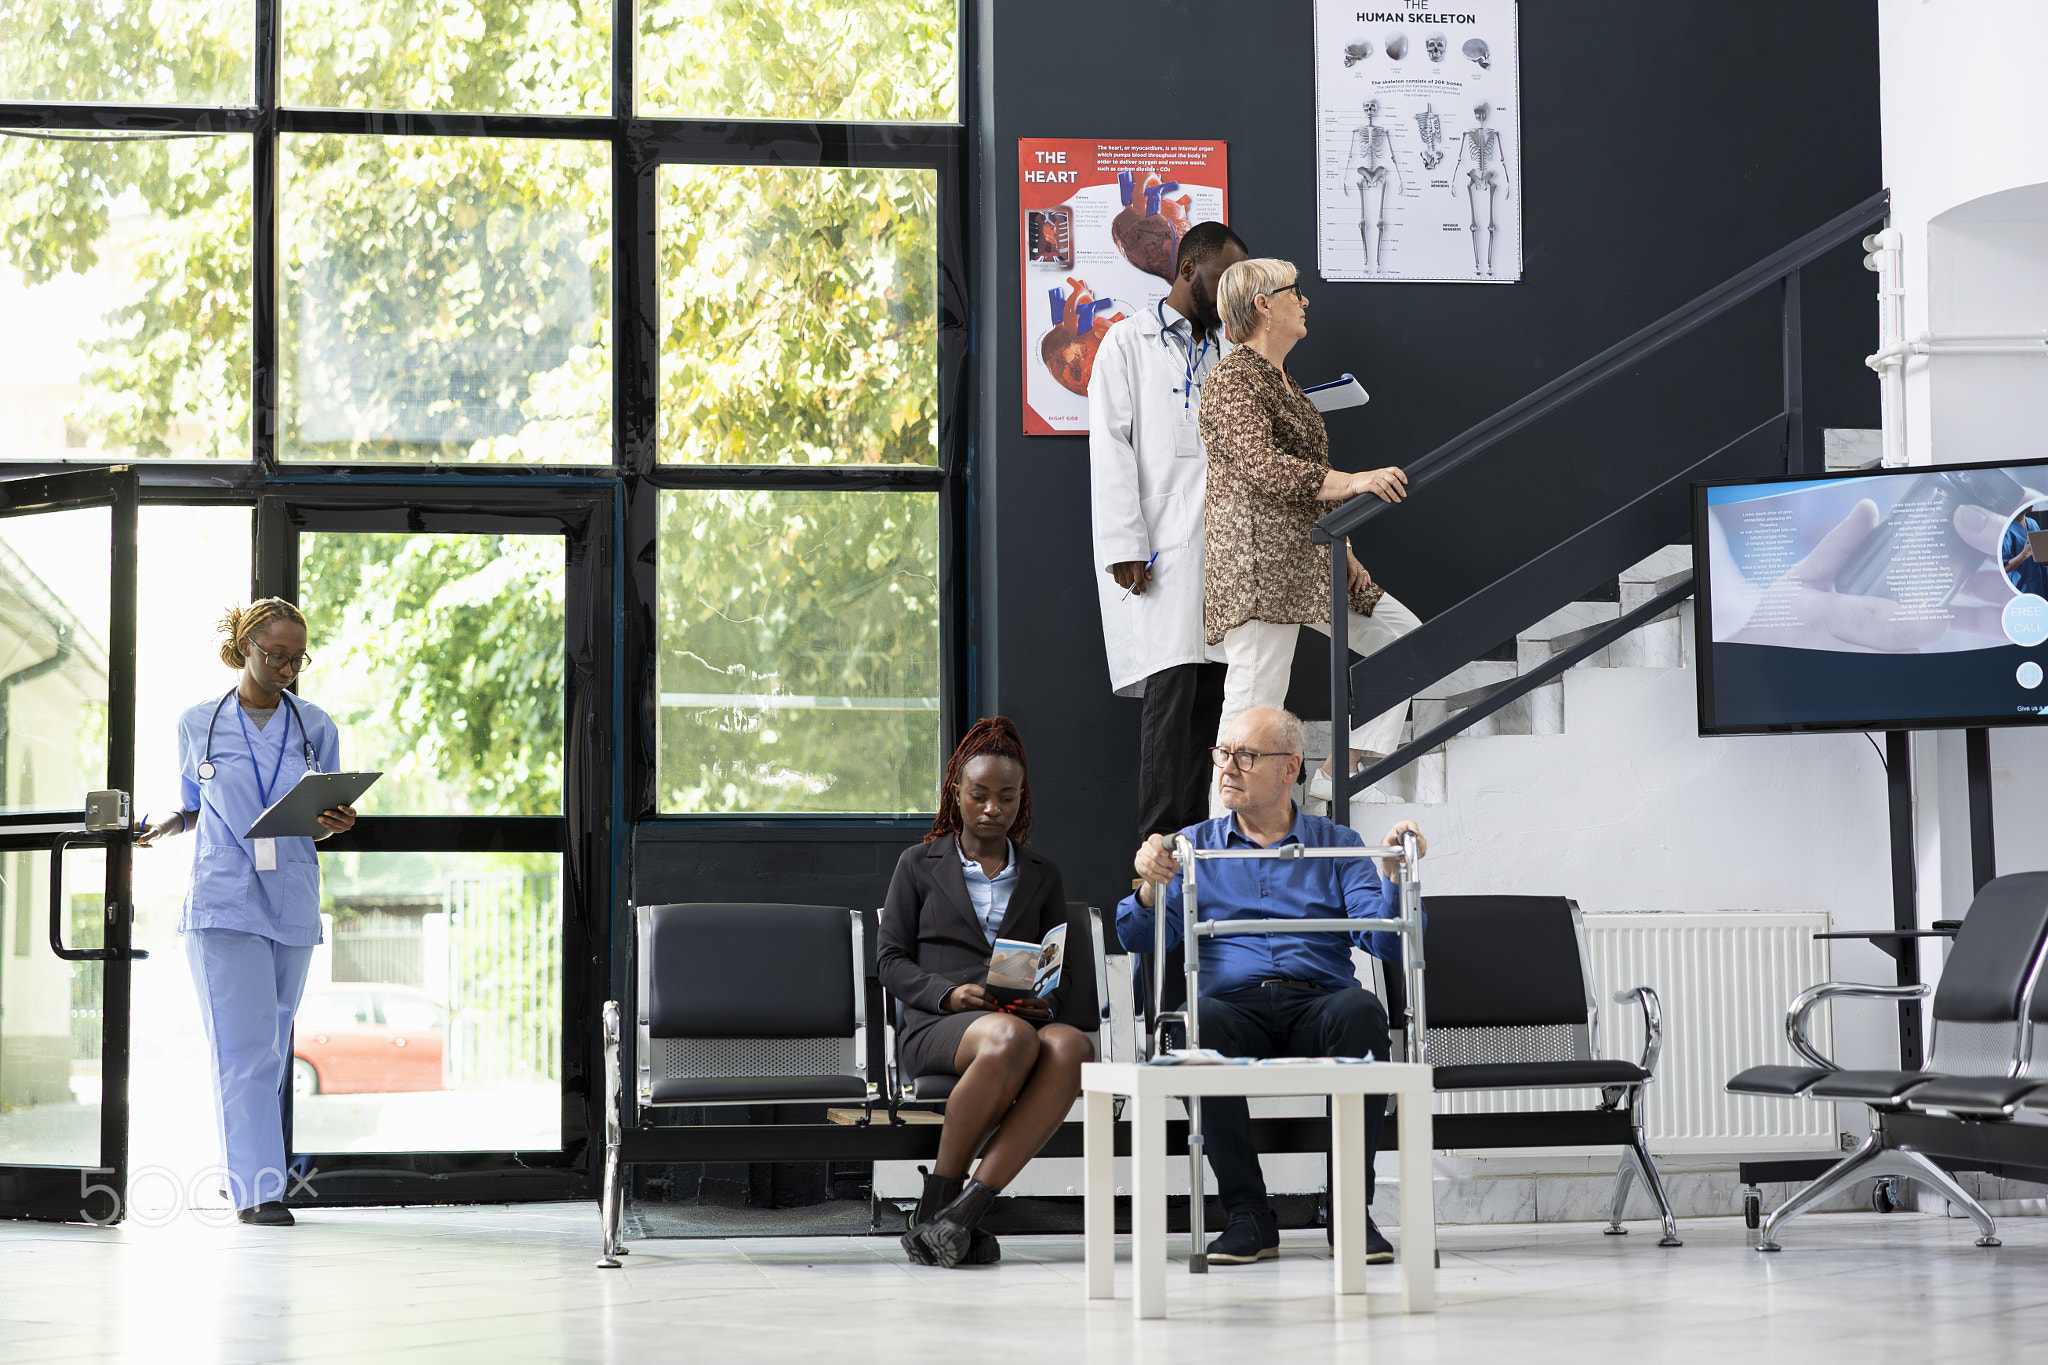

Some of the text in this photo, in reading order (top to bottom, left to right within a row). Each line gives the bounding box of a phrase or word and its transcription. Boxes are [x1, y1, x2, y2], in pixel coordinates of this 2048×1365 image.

[1404, 0, 1428, 10] THE
[1356, 12, 1475, 24] HUMAN SKELETON
[1035, 151, 1066, 164] THE
[1024, 170, 1078, 183] HEART
[2011, 606, 2042, 616] FREE
[2014, 623, 2042, 633] CALL
